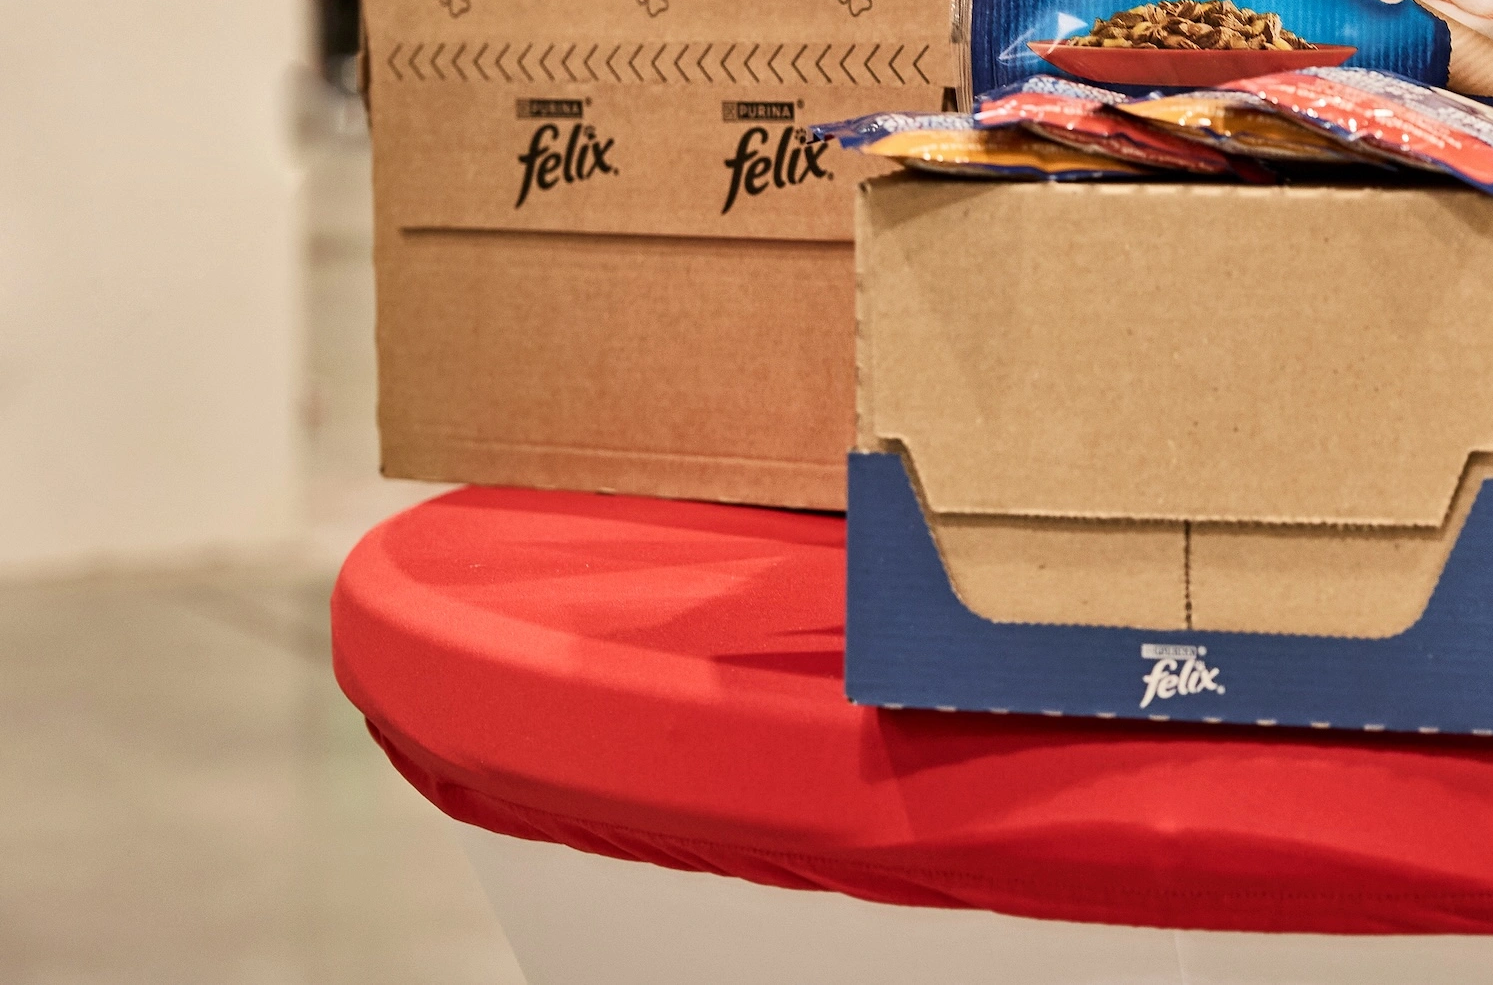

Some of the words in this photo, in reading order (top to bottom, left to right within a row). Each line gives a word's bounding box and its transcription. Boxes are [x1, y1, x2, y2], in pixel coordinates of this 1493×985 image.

[738, 103, 792, 118] PURINA
[515, 124, 615, 209] felix
[721, 126, 829, 215] felix
[1139, 659, 1220, 709] felix
